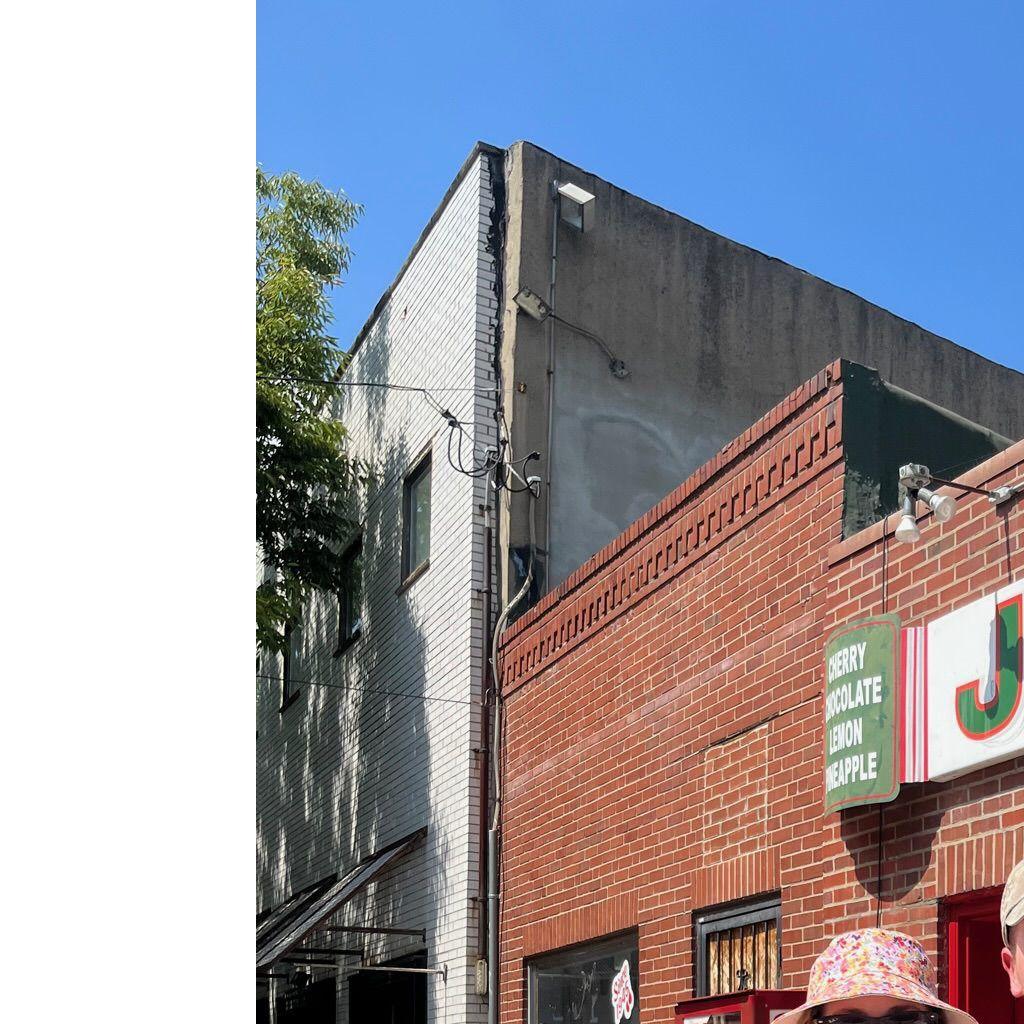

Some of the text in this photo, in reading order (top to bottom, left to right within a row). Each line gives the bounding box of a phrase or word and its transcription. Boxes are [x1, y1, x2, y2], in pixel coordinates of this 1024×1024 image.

[828, 641, 867, 684] CHERRY
[826, 675, 882, 723] HOCOLATE
[829, 717, 863, 756] LEMON
[826, 751, 878, 795] INEAPPLE
